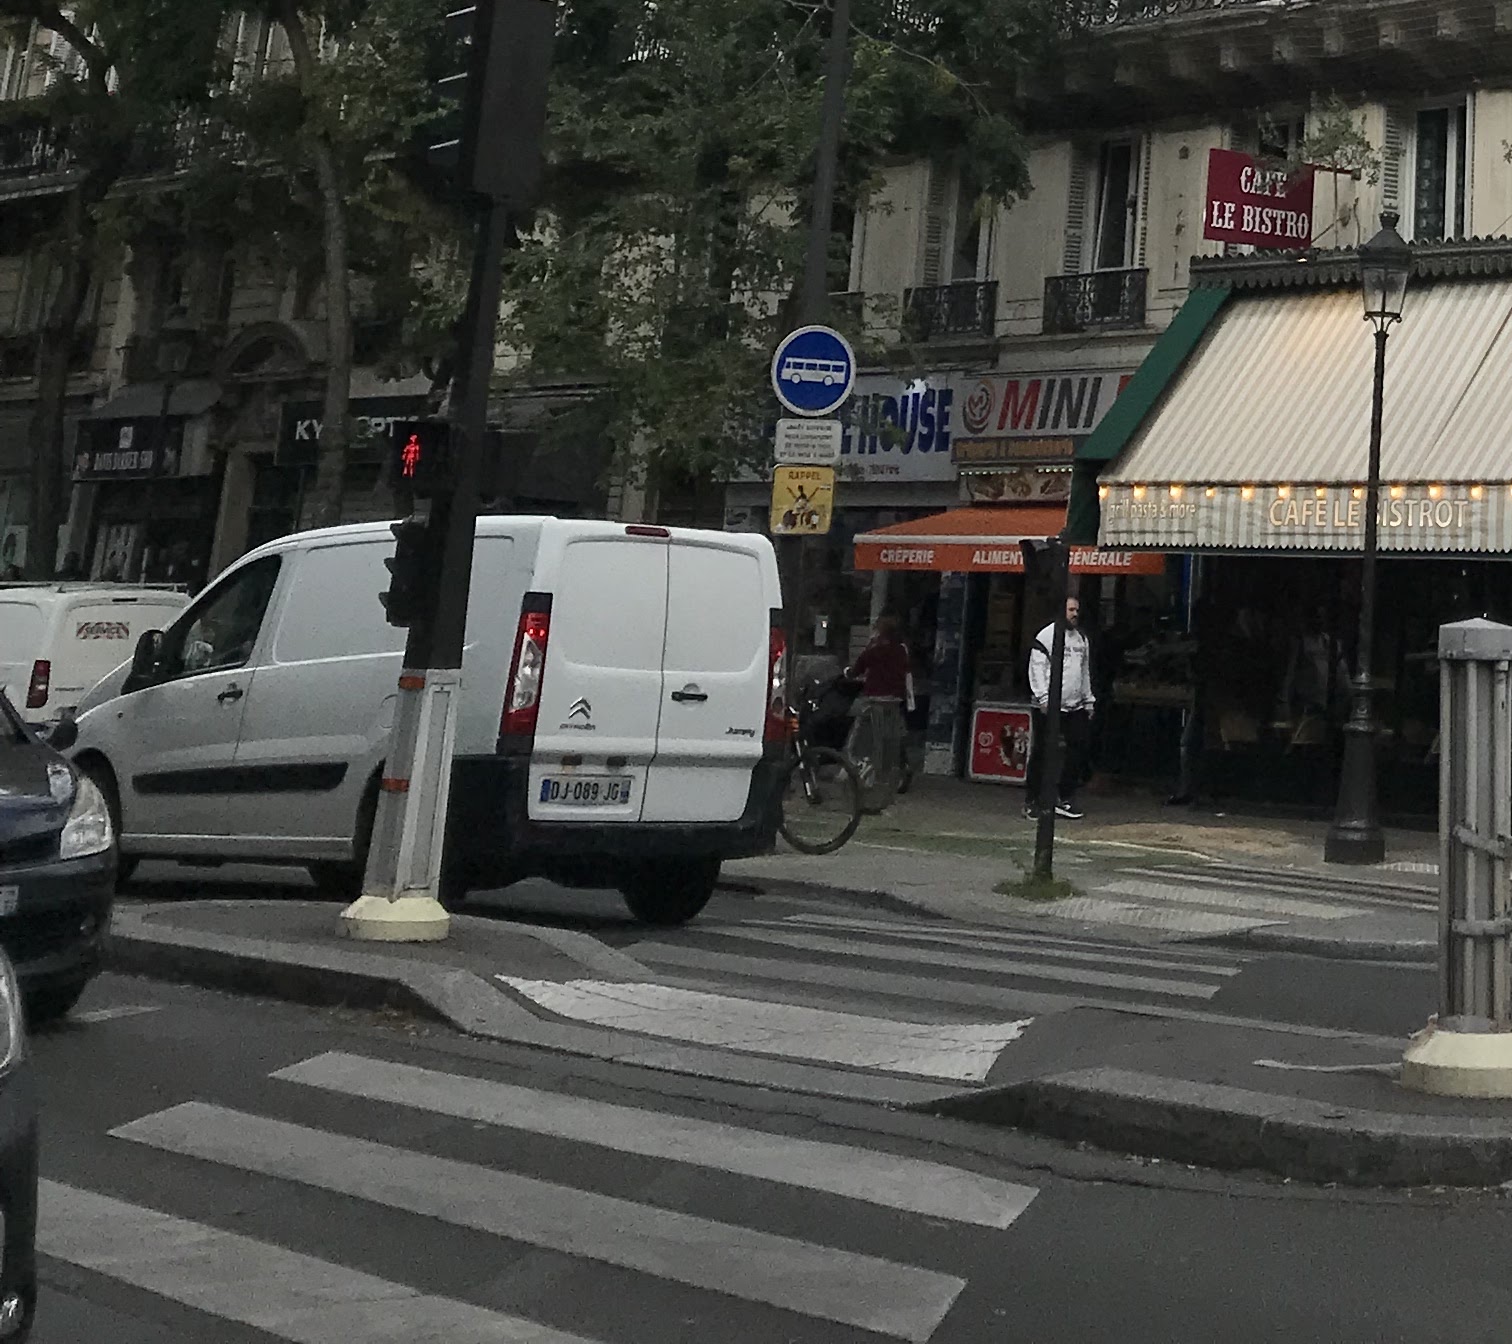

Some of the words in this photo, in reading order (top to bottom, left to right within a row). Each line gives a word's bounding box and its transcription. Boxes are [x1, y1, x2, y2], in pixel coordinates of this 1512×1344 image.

[1211, 200, 1236, 230] LE
[1241, 205, 1309, 240] BISTRO
[997, 376, 1102, 430] MINI
[1269, 499, 1328, 527] CAFE
[1333, 500, 1361, 528] LE
[1375, 499, 1470, 529] ISTROT
[972, 550, 1024, 564] ALIMENT
